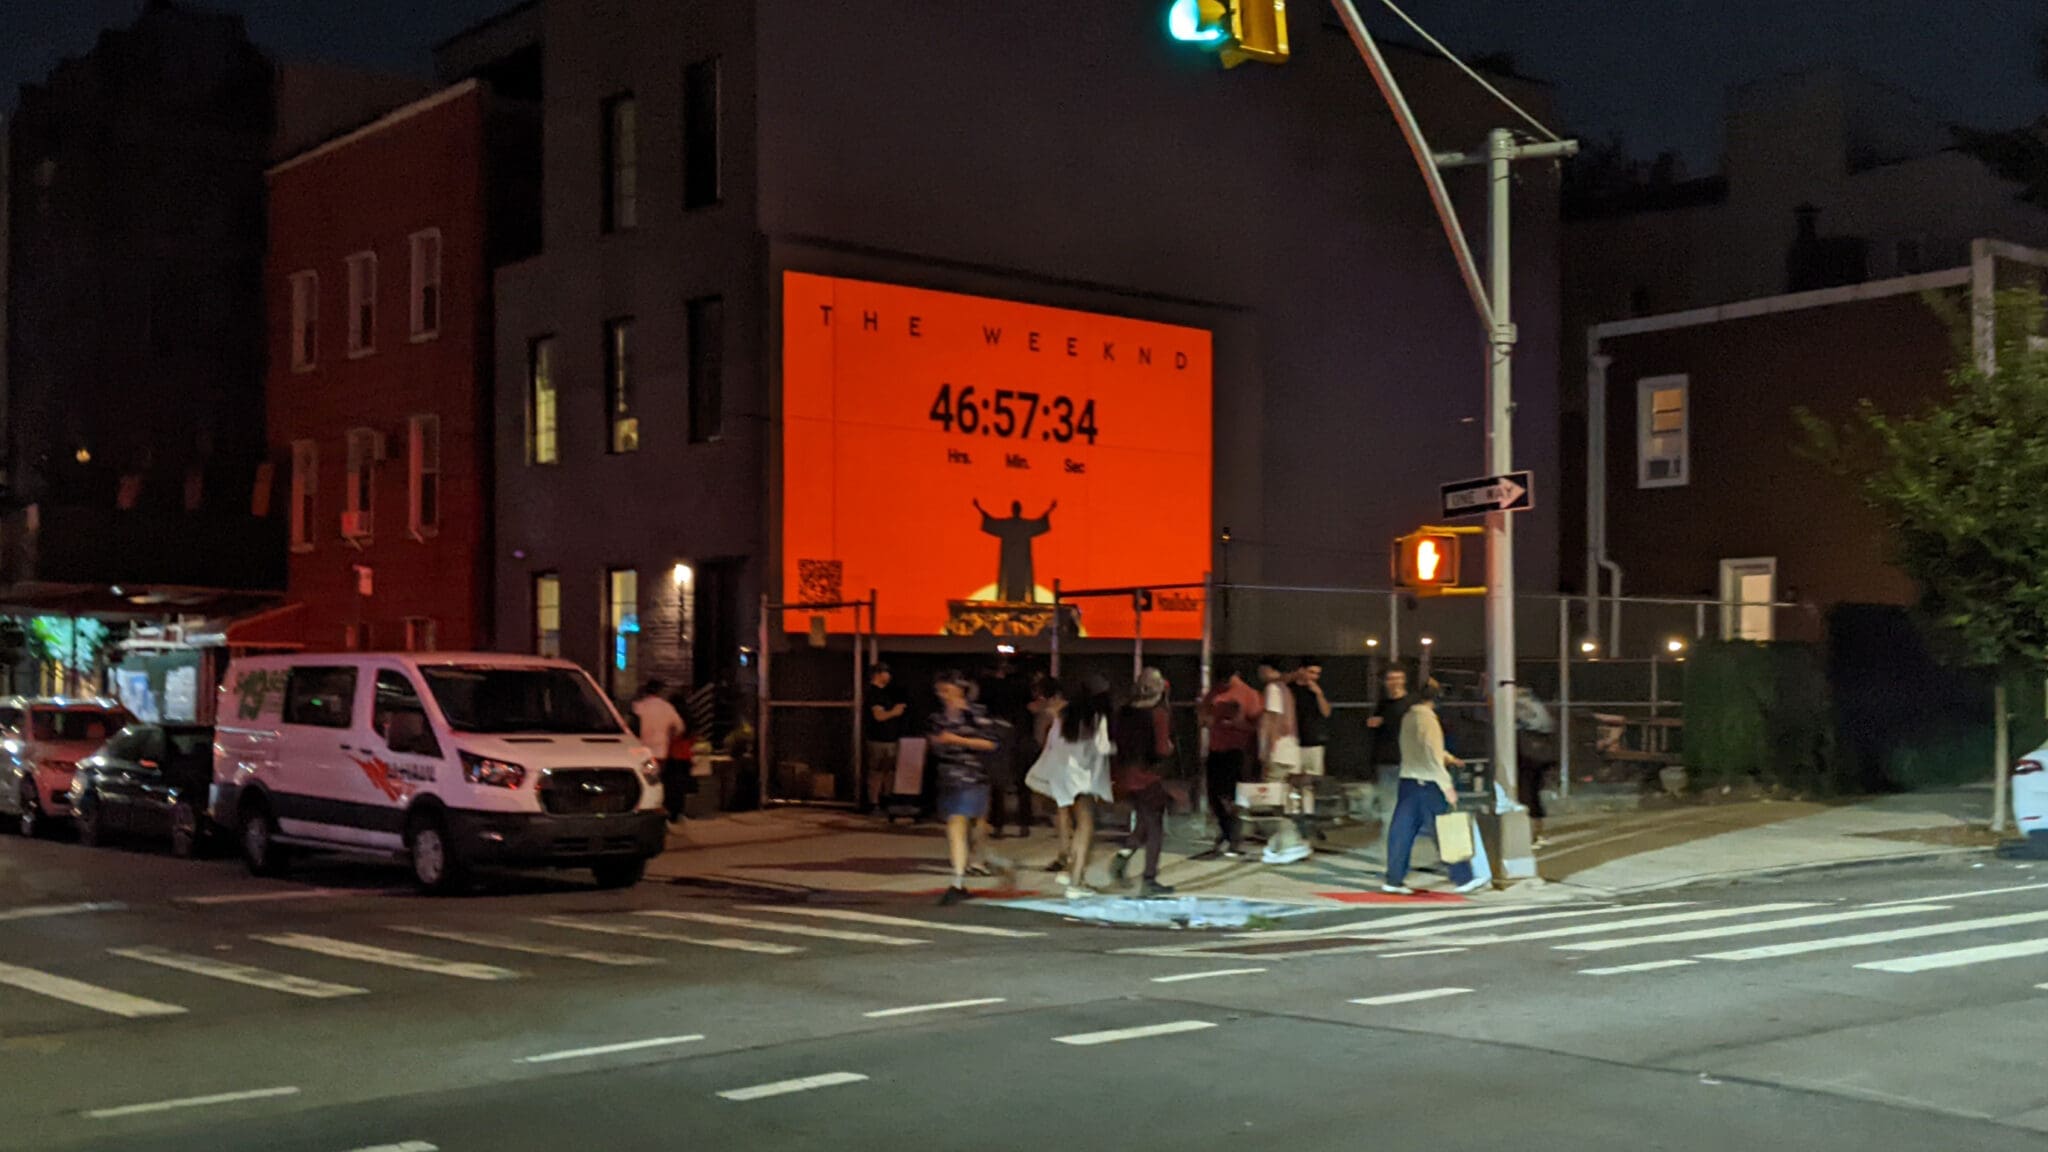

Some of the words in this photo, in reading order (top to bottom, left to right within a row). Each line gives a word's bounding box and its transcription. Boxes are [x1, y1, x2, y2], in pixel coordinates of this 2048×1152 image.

[820, 305, 922, 337] THE
[983, 326, 1188, 370] WEEKND
[929, 383, 1098, 445] 46:57:34
